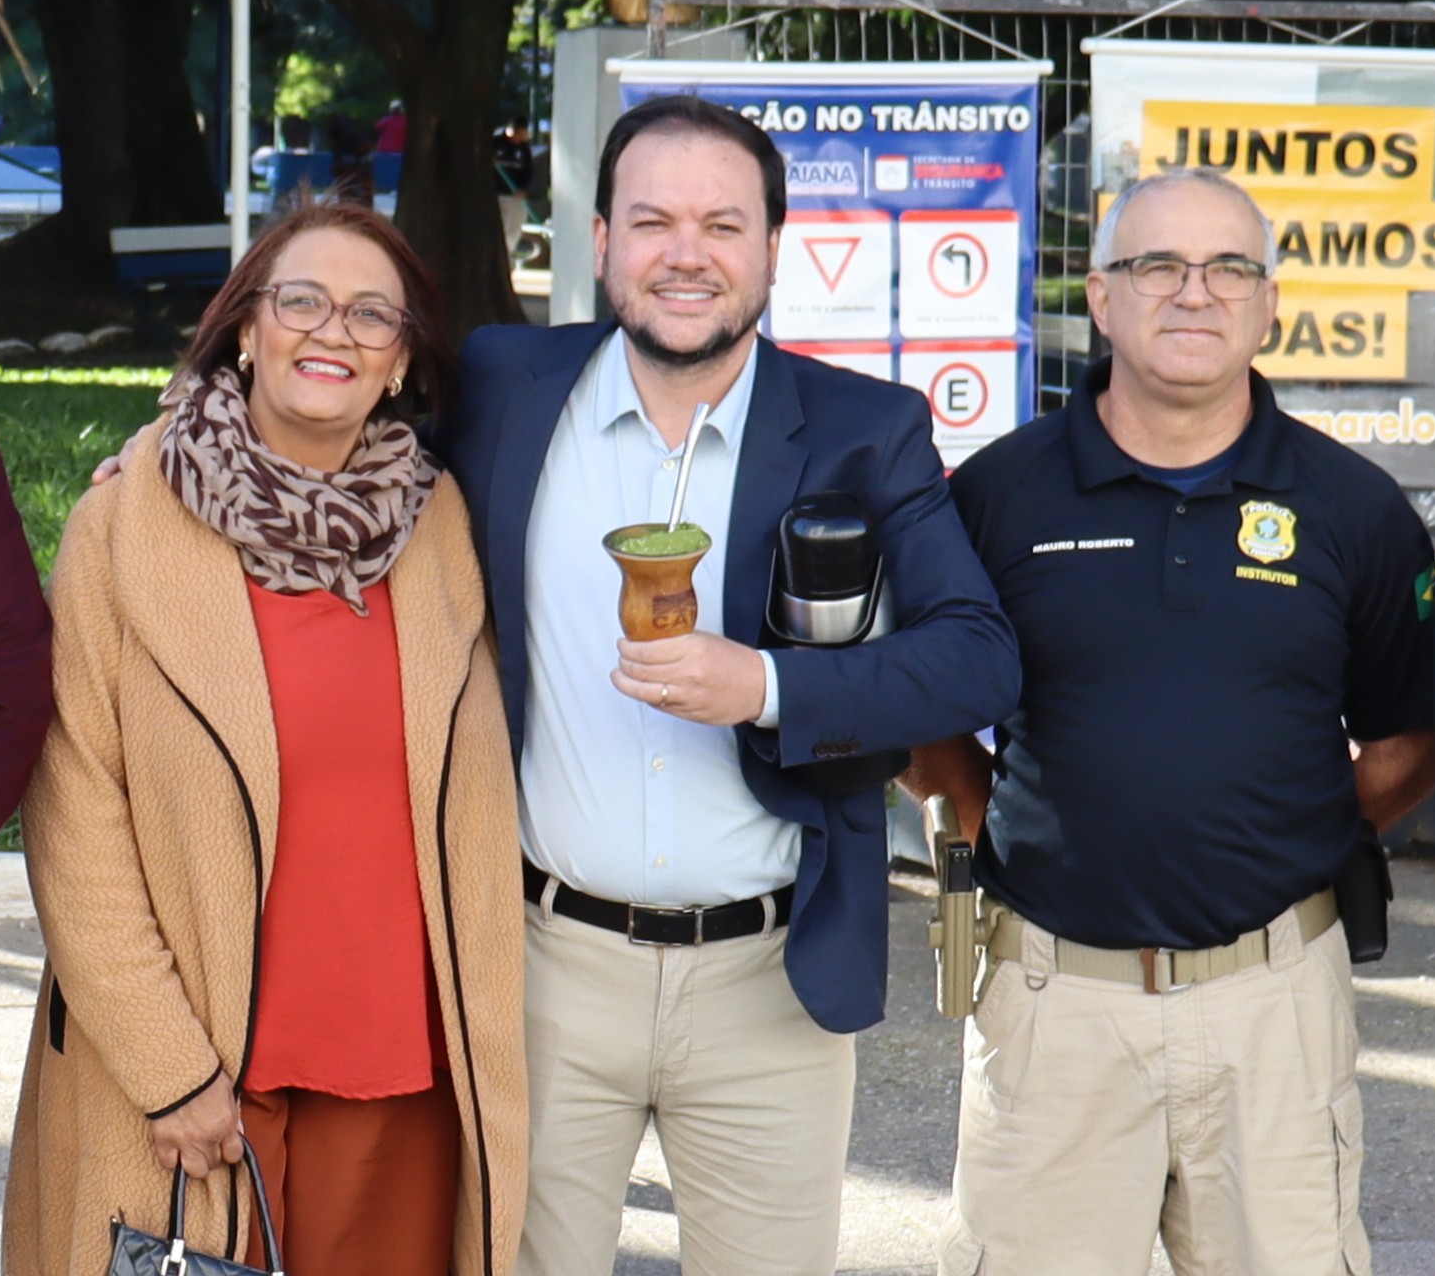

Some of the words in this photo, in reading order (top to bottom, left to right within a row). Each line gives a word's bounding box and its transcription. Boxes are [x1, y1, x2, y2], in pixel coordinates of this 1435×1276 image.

[726, 100, 808, 132] ÇÃO
[816, 105, 864, 131] NO
[871, 100, 1031, 132] TRÂNSITO
[1155, 127, 1419, 179] JUNTOS
[947, 378, 969, 412] E
[1032, 540, 1076, 554] MAURO
[1077, 538, 1135, 550] ROBERTO
[1235, 565, 1298, 587] INSTRUTOR
